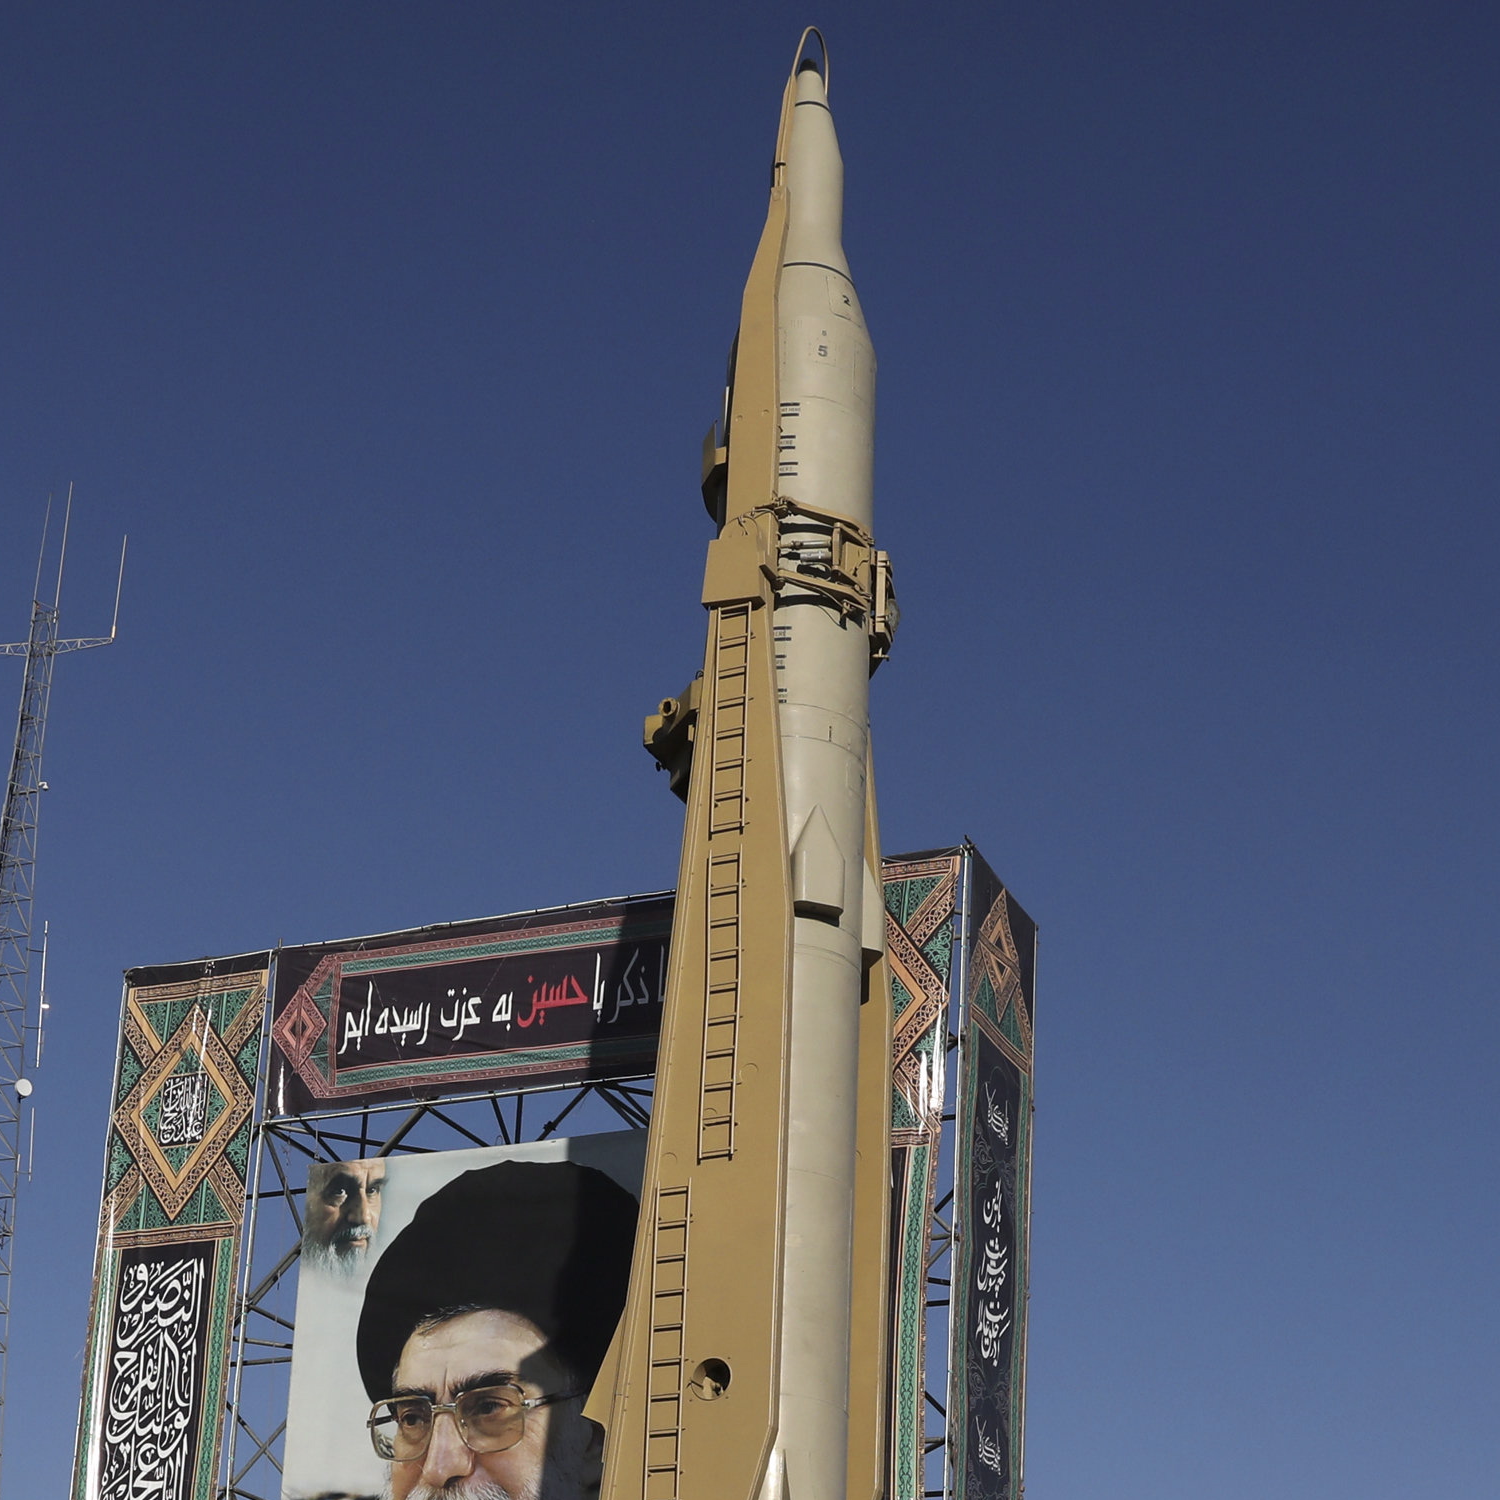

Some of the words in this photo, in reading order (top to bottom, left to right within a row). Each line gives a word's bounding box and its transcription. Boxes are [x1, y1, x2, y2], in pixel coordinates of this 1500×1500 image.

[842, 294, 852, 307] 2
[817, 345, 828, 357] 5
[491, 991, 513, 1032] به
[516, 974, 588, 1028] حسین
[592, 952, 607, 1024] یا
[607, 948, 649, 1024] ذکر
[337, 980, 374, 1055] ایم
[375, 998, 431, 1046] رسیده
[440, 986, 481, 1041] عزت
